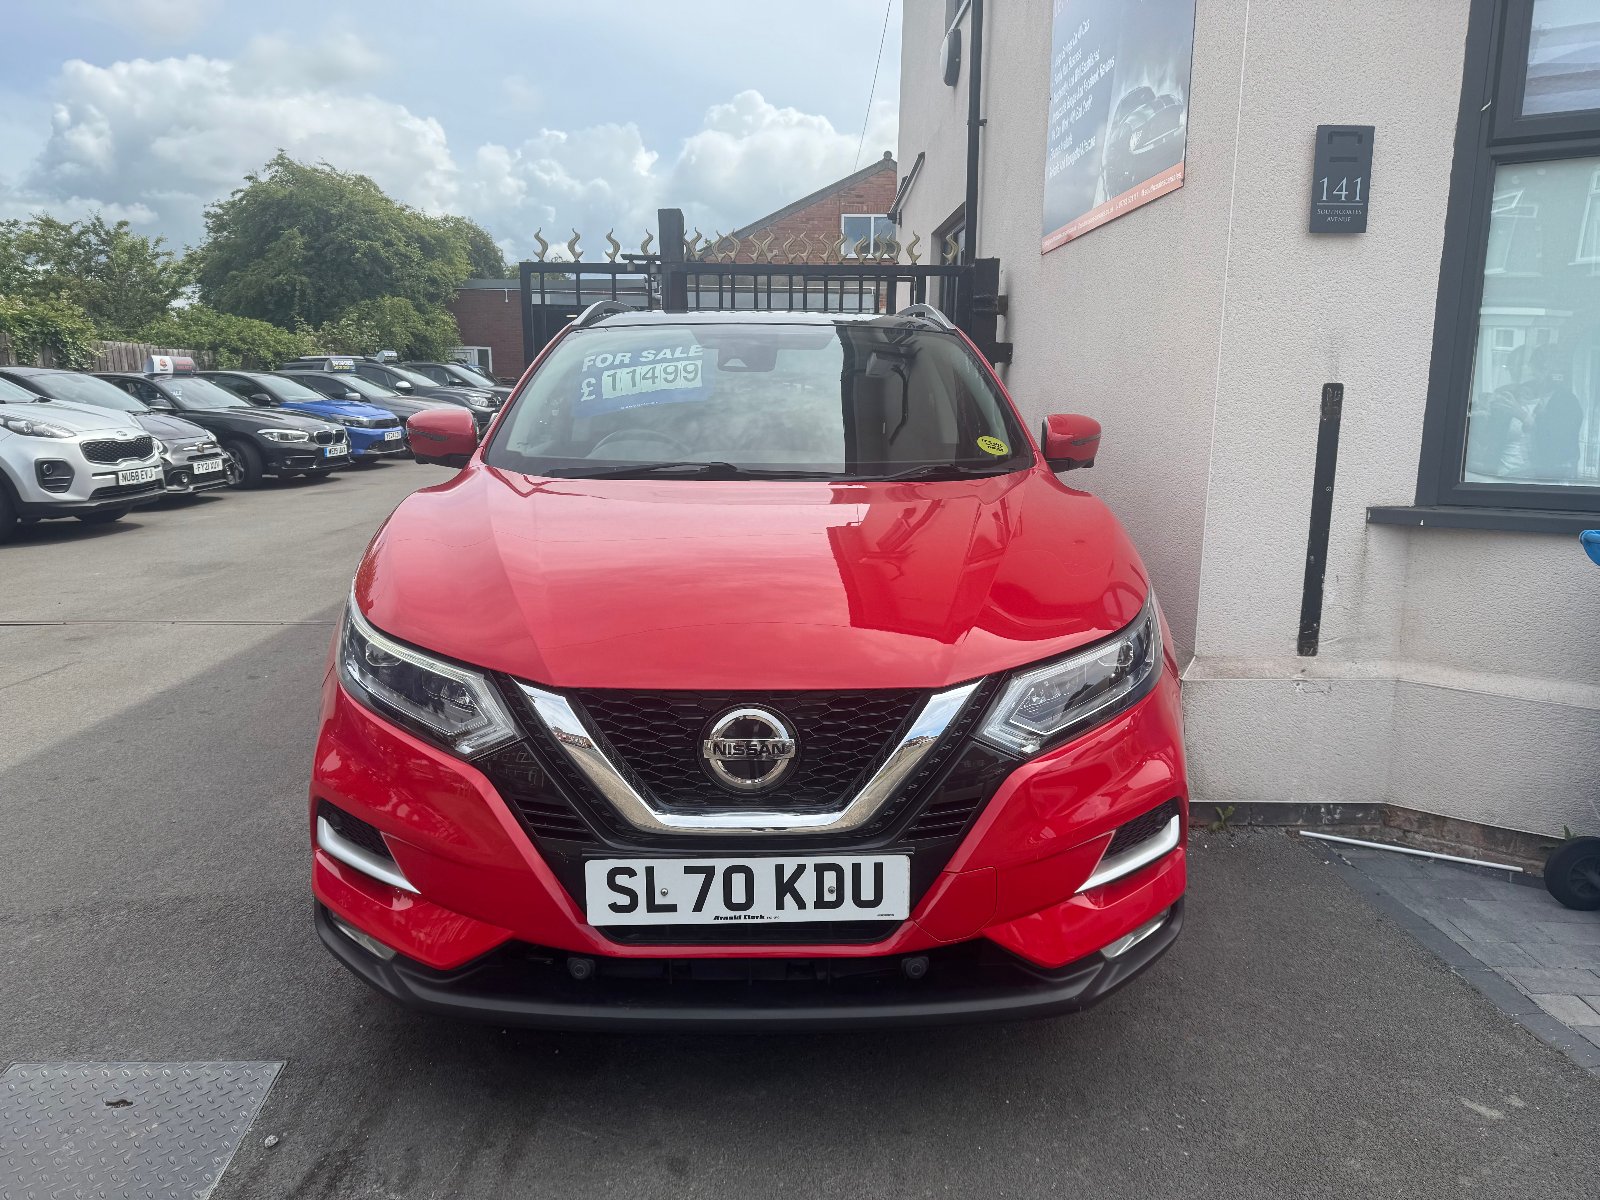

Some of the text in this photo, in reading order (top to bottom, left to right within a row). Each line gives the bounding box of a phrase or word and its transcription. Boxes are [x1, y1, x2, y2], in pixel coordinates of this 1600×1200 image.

[1319, 176, 1362, 201] 141
[581, 344, 704, 372] FOR SALE
[606, 362, 699, 392] 11499
[713, 742, 787, 756] NISSAN
[606, 861, 884, 914] SL70 KDU
